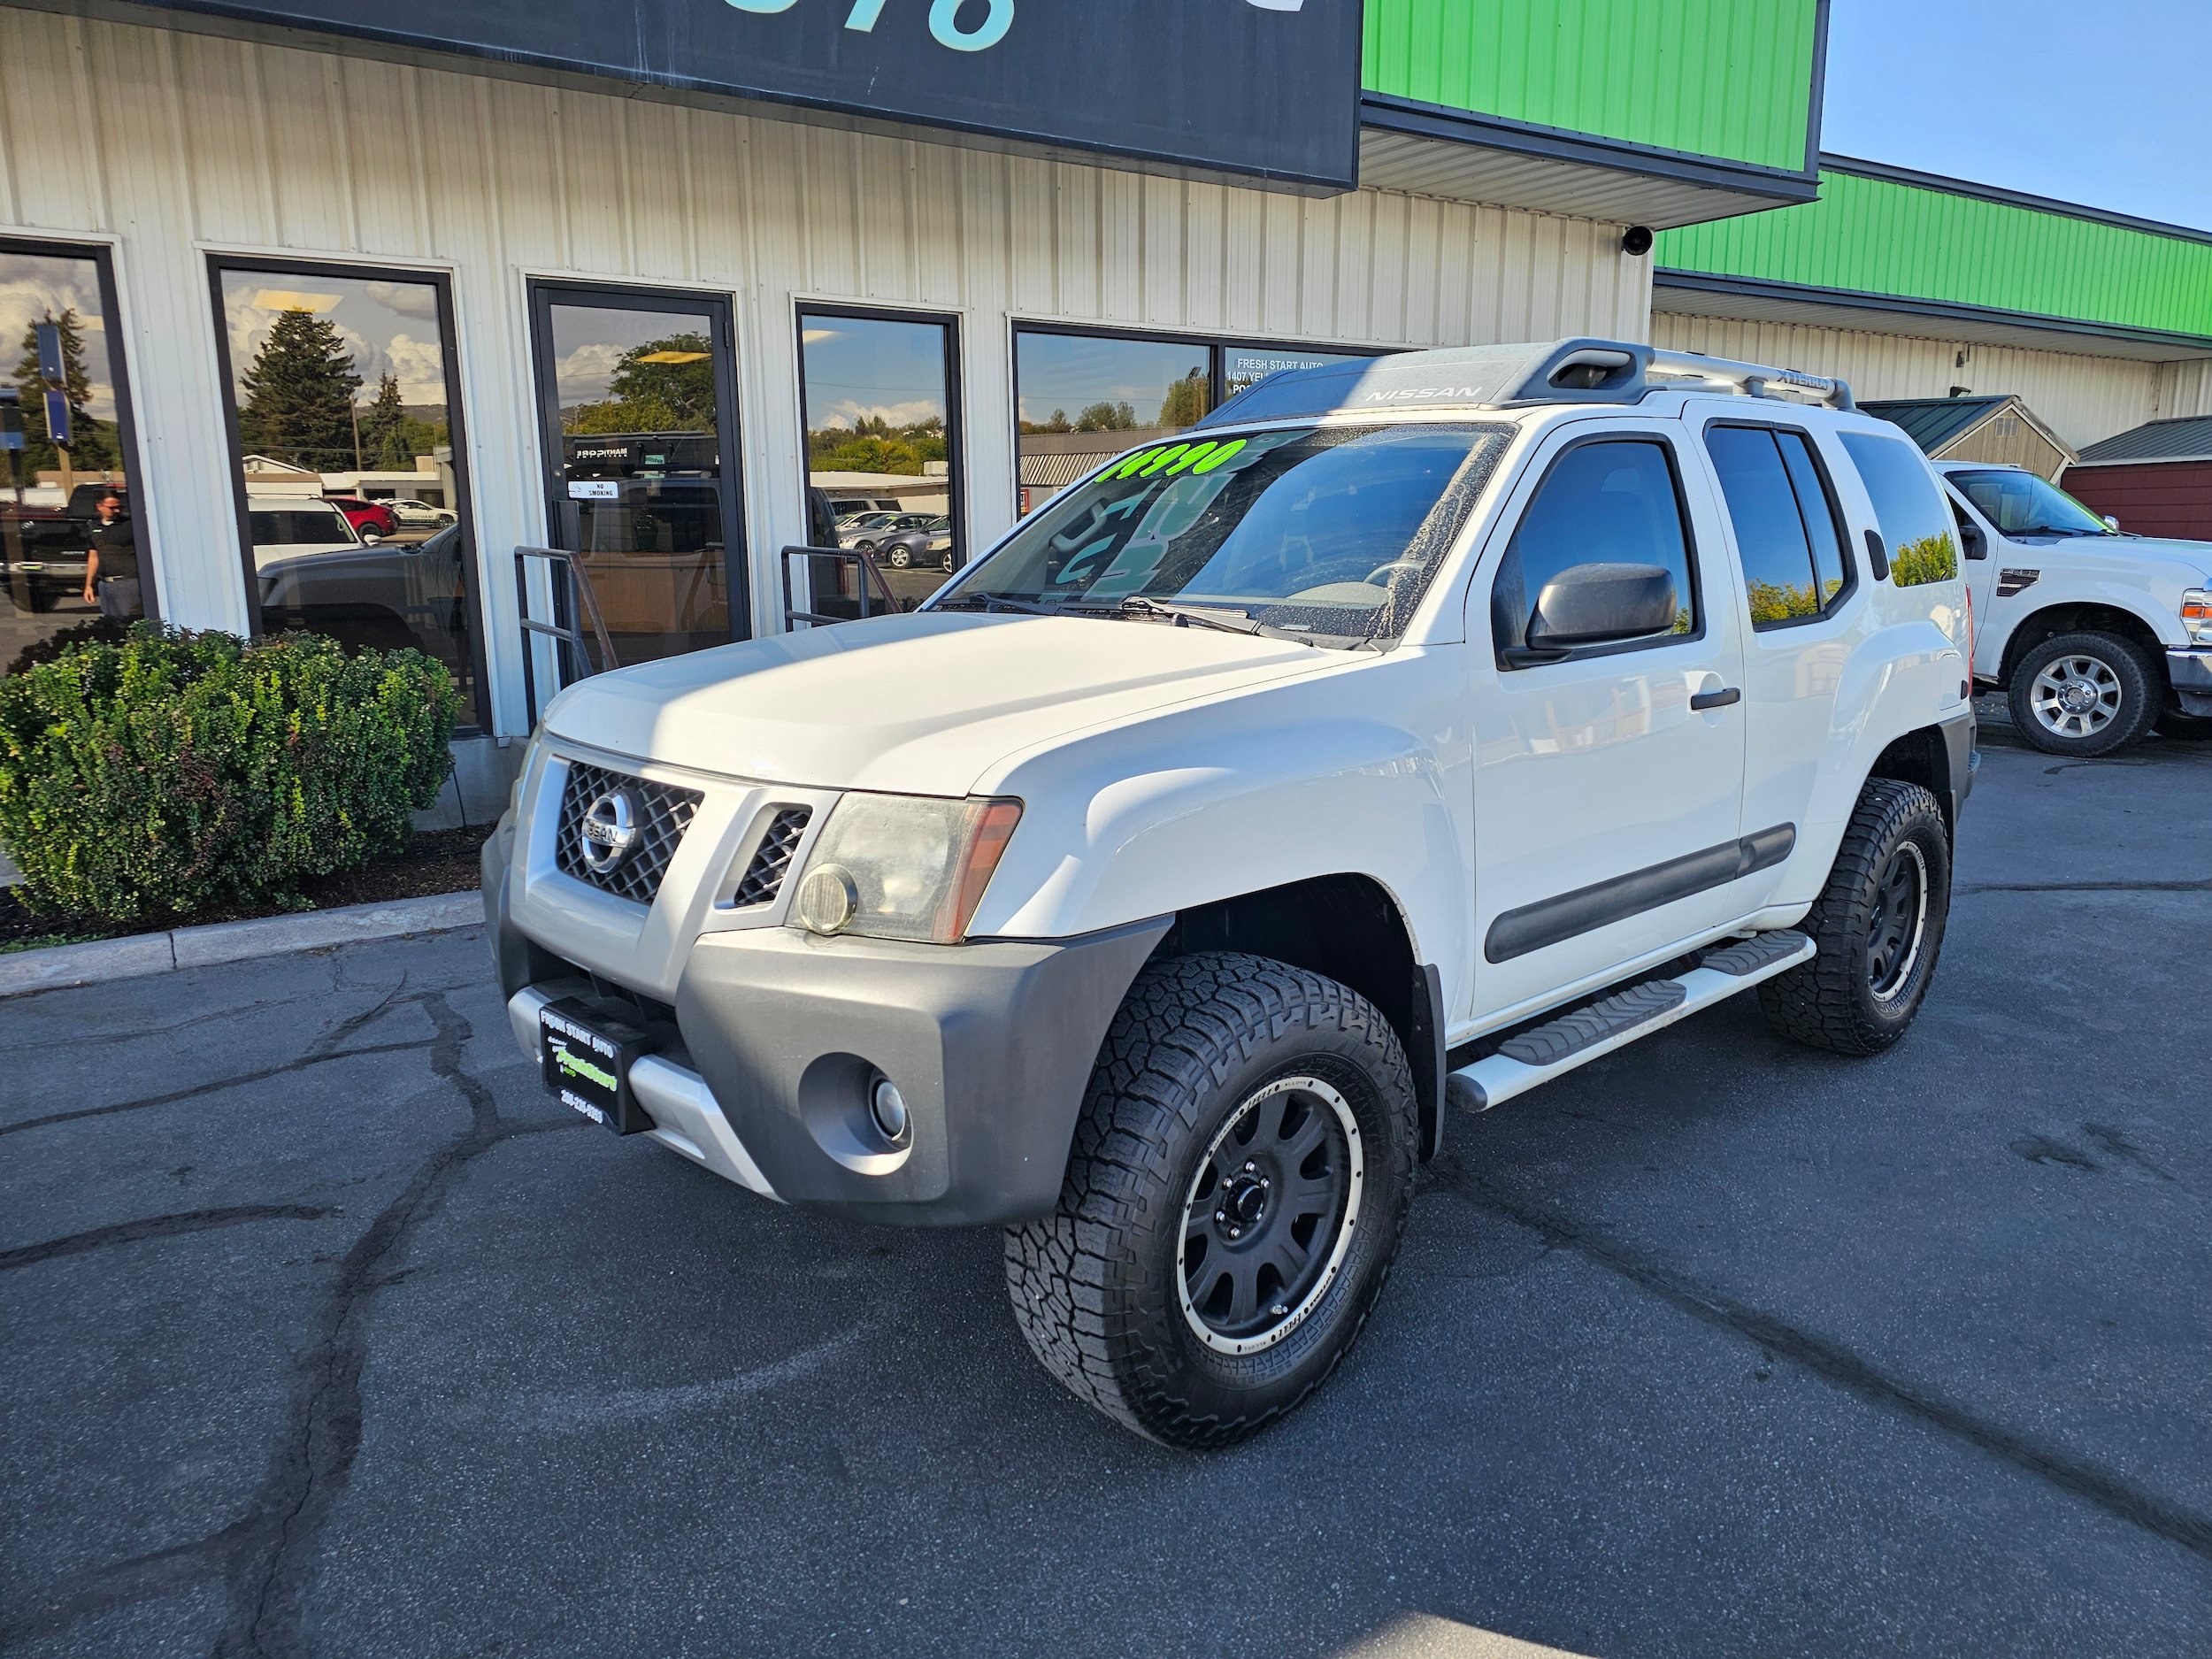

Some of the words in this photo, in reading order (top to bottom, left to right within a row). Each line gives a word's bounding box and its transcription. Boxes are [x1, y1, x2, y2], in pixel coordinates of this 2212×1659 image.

[1237, 358, 1268, 369] FRESH
[1270, 360, 1298, 370] START
[1226, 371, 1247, 381] 1407
[1365, 387, 1483, 402] NISSAN
[540, 1010, 566, 1033] FRESH
[566, 1023, 591, 1046] START
[592, 1036, 614, 1059] AUTO
